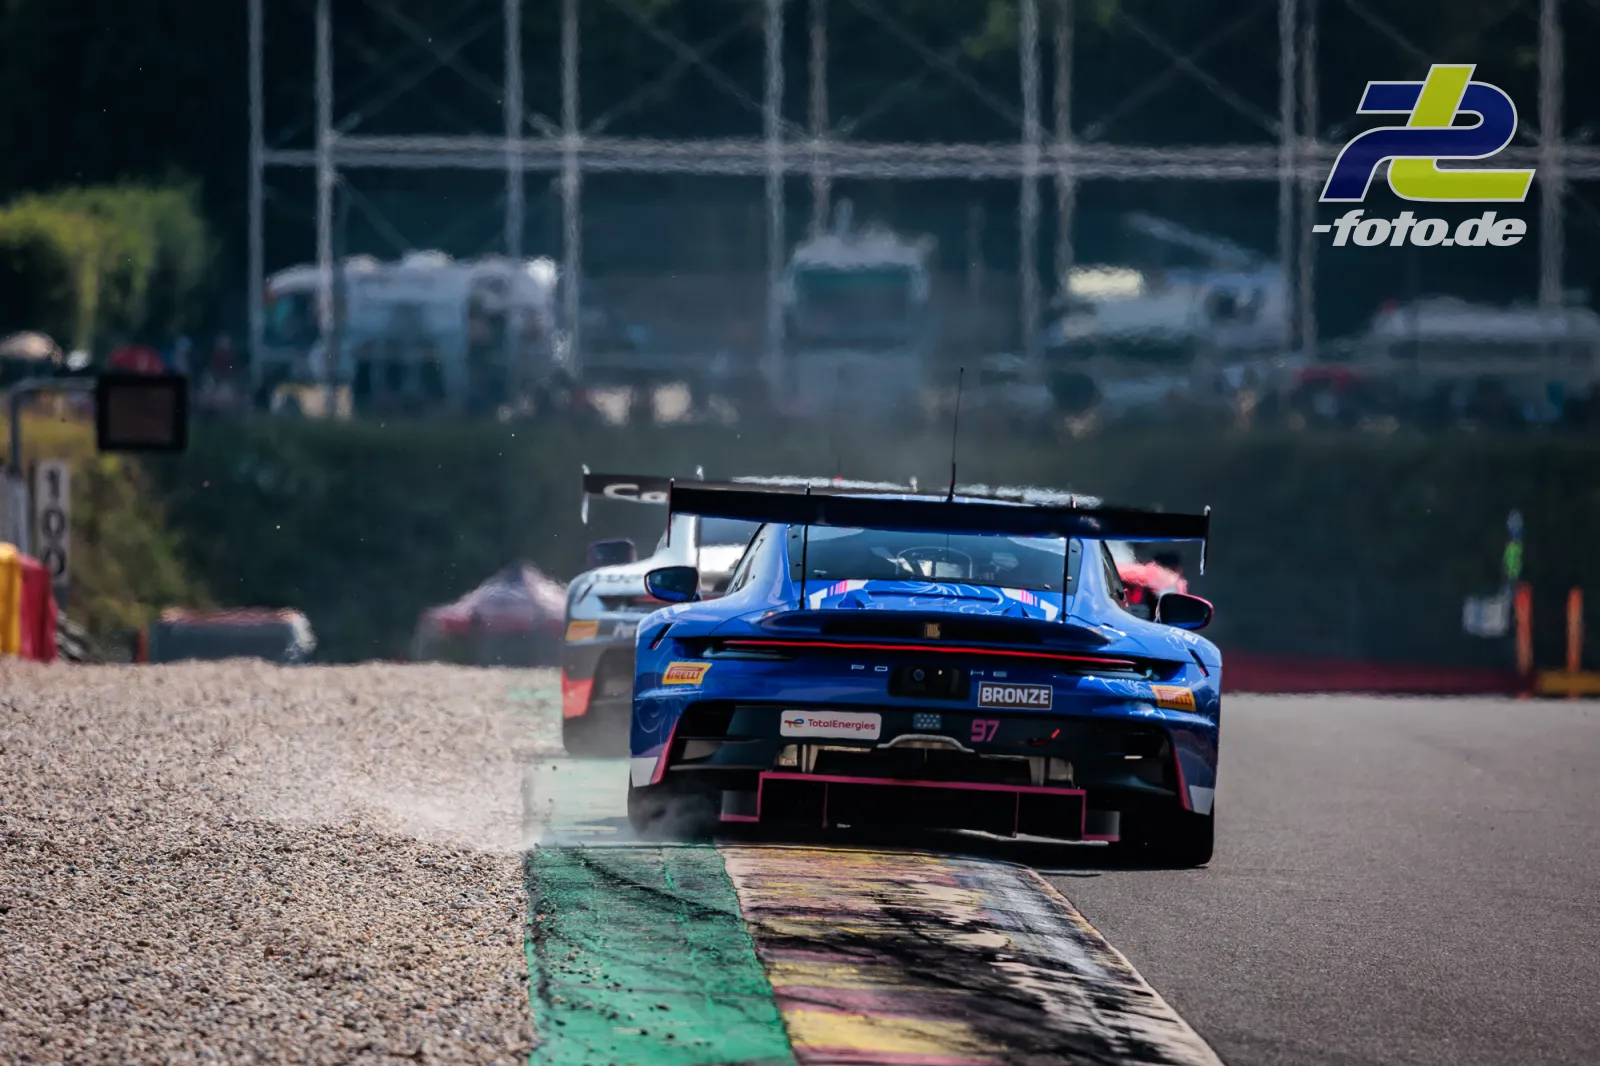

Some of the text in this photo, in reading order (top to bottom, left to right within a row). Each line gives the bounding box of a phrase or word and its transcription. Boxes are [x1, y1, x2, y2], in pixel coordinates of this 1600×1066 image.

[41, 467, 67, 578] 100
[666, 665, 704, 681] PIRELLI
[981, 686, 1050, 705] BRONZE
[807, 718, 876, 731] TotalEnergies
[970, 718, 1001, 743] 97
